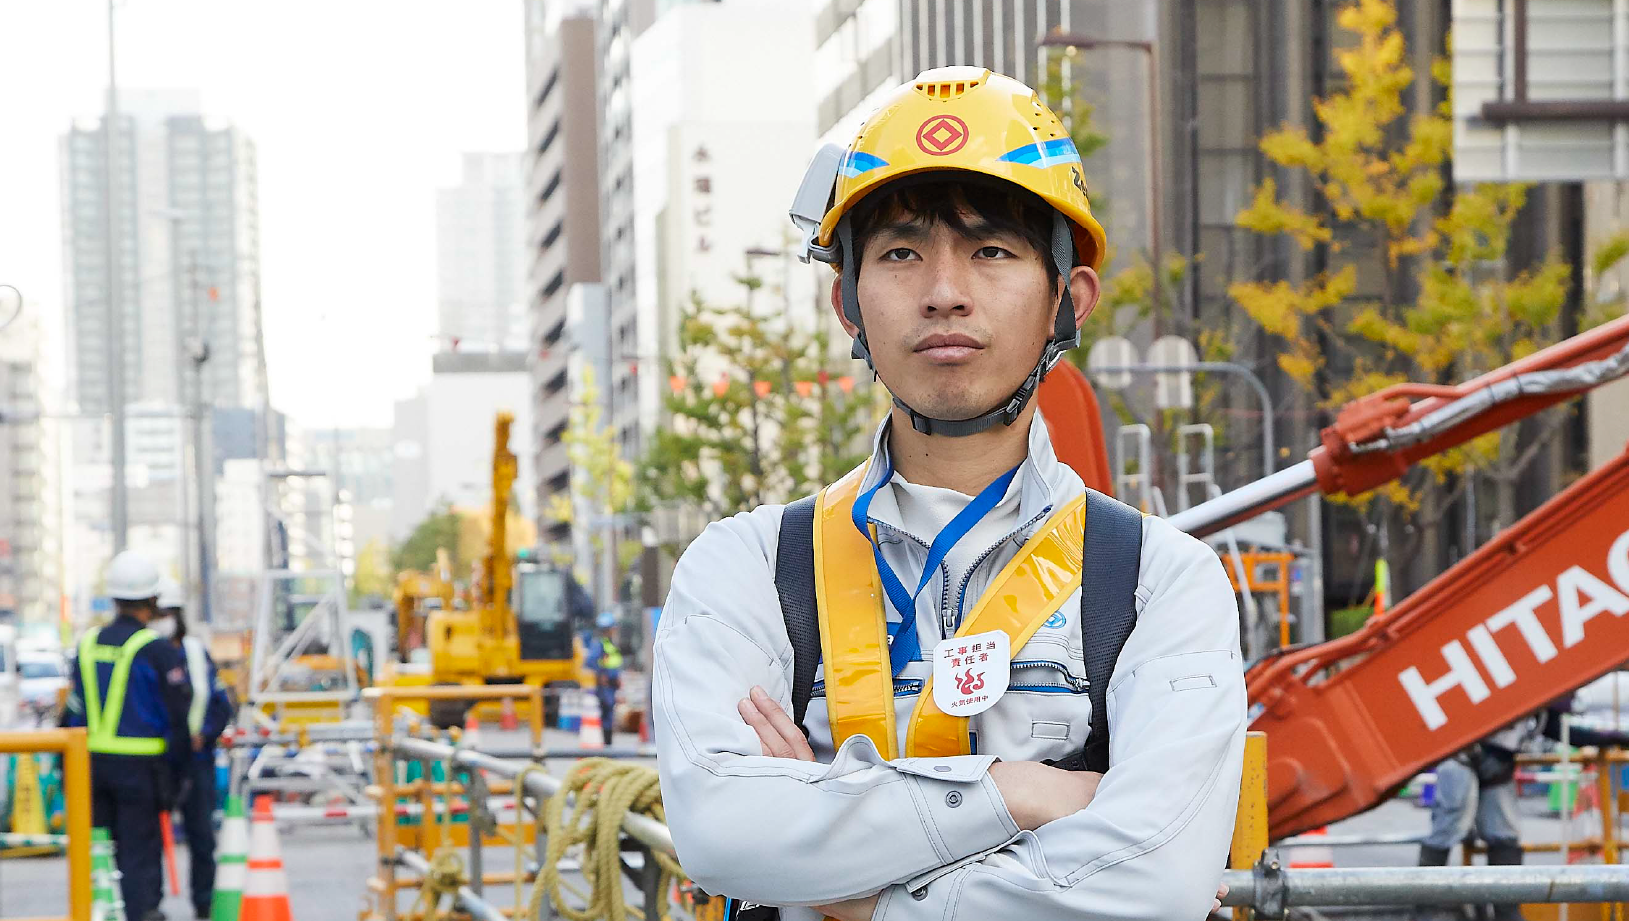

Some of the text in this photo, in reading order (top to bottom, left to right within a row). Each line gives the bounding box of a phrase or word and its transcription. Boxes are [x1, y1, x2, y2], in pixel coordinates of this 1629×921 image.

[944, 641, 996, 658] 工事担当
[951, 653, 989, 668] 責任者
[951, 695, 989, 708] 火気使用中
